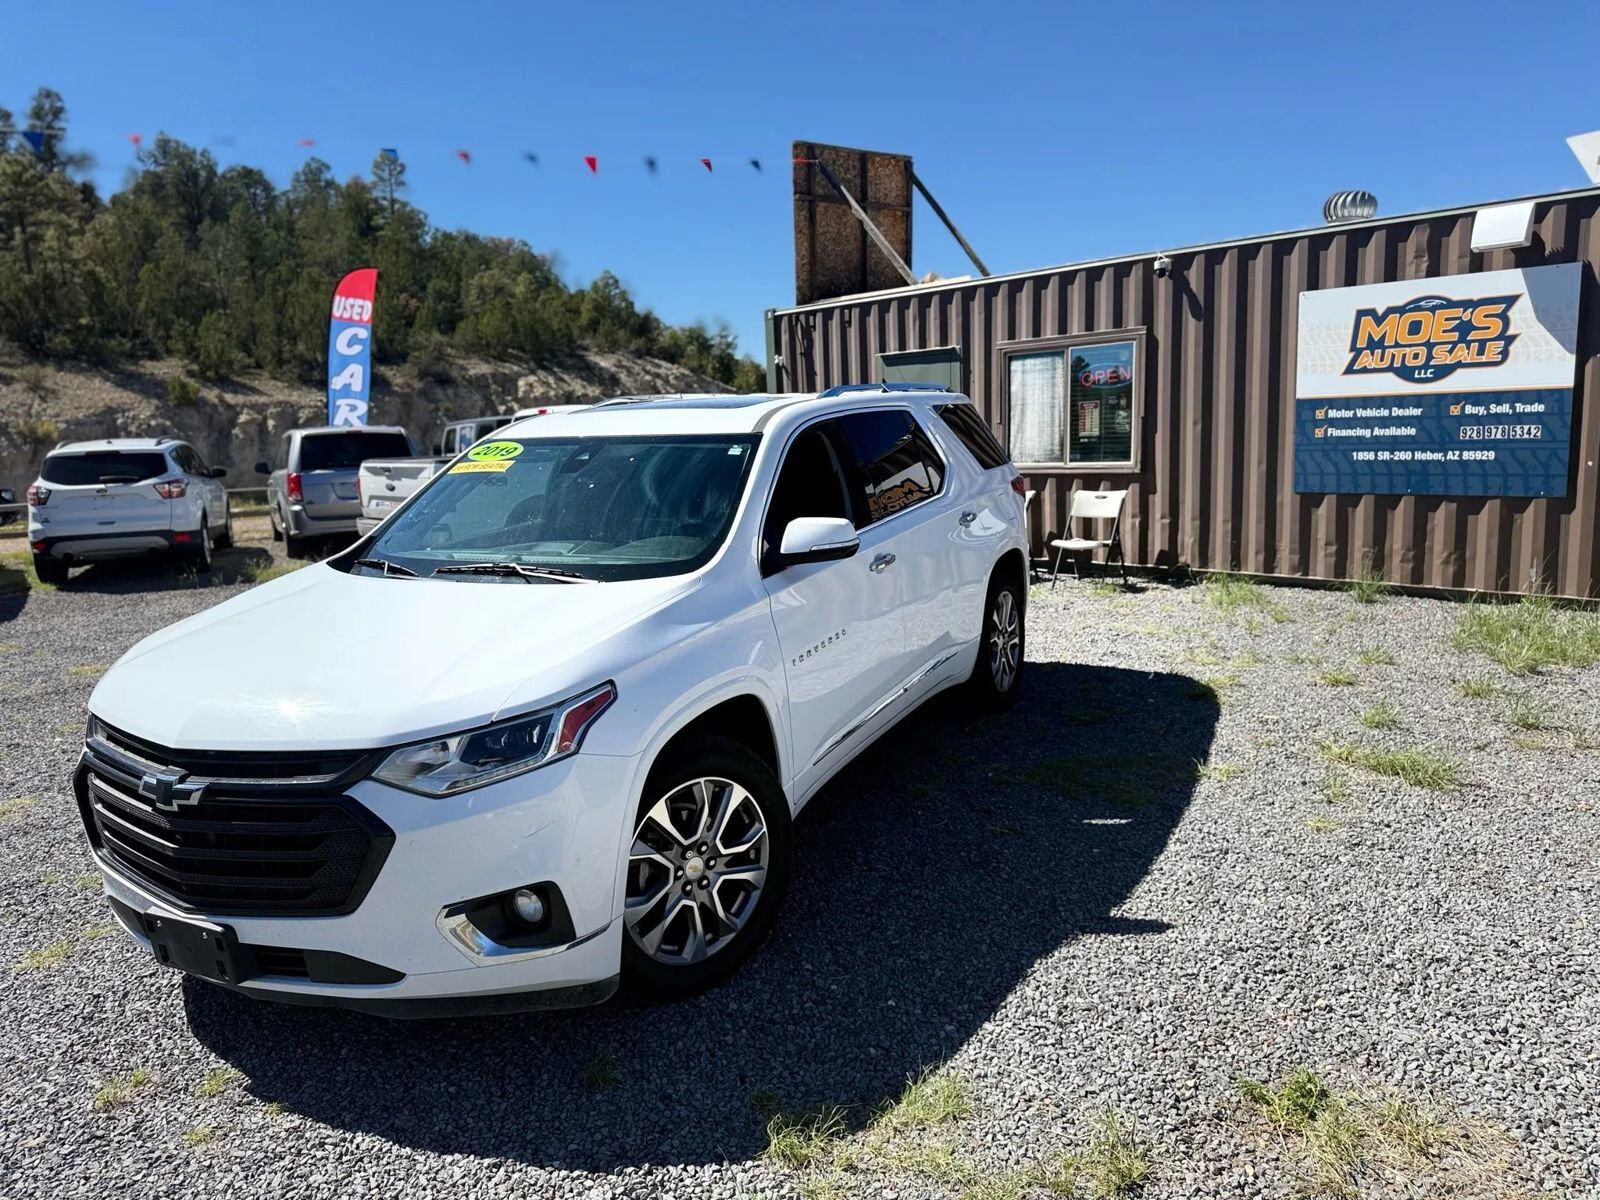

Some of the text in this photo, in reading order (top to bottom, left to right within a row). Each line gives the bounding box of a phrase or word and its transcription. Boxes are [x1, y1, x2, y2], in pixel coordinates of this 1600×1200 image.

[332, 295, 372, 322] USED
[1356, 304, 1507, 348] MOE'S
[1353, 340, 1505, 369] AUTO SALE
[331, 327, 368, 427] CAR
[1081, 366, 1132, 386] OPEN
[1414, 368, 1435, 378] LLC
[1327, 406, 1423, 418] Motor Vehicle Dealer
[1465, 402, 1545, 416] Buy, Sell, Trade
[1327, 426, 1416, 438] Financing Available
[1461, 425, 1540, 439] 928 978 5342
[473, 446, 518, 457] 2019
[1352, 450, 1495, 461] 1856 SR-260 Heber, AZ 85929
